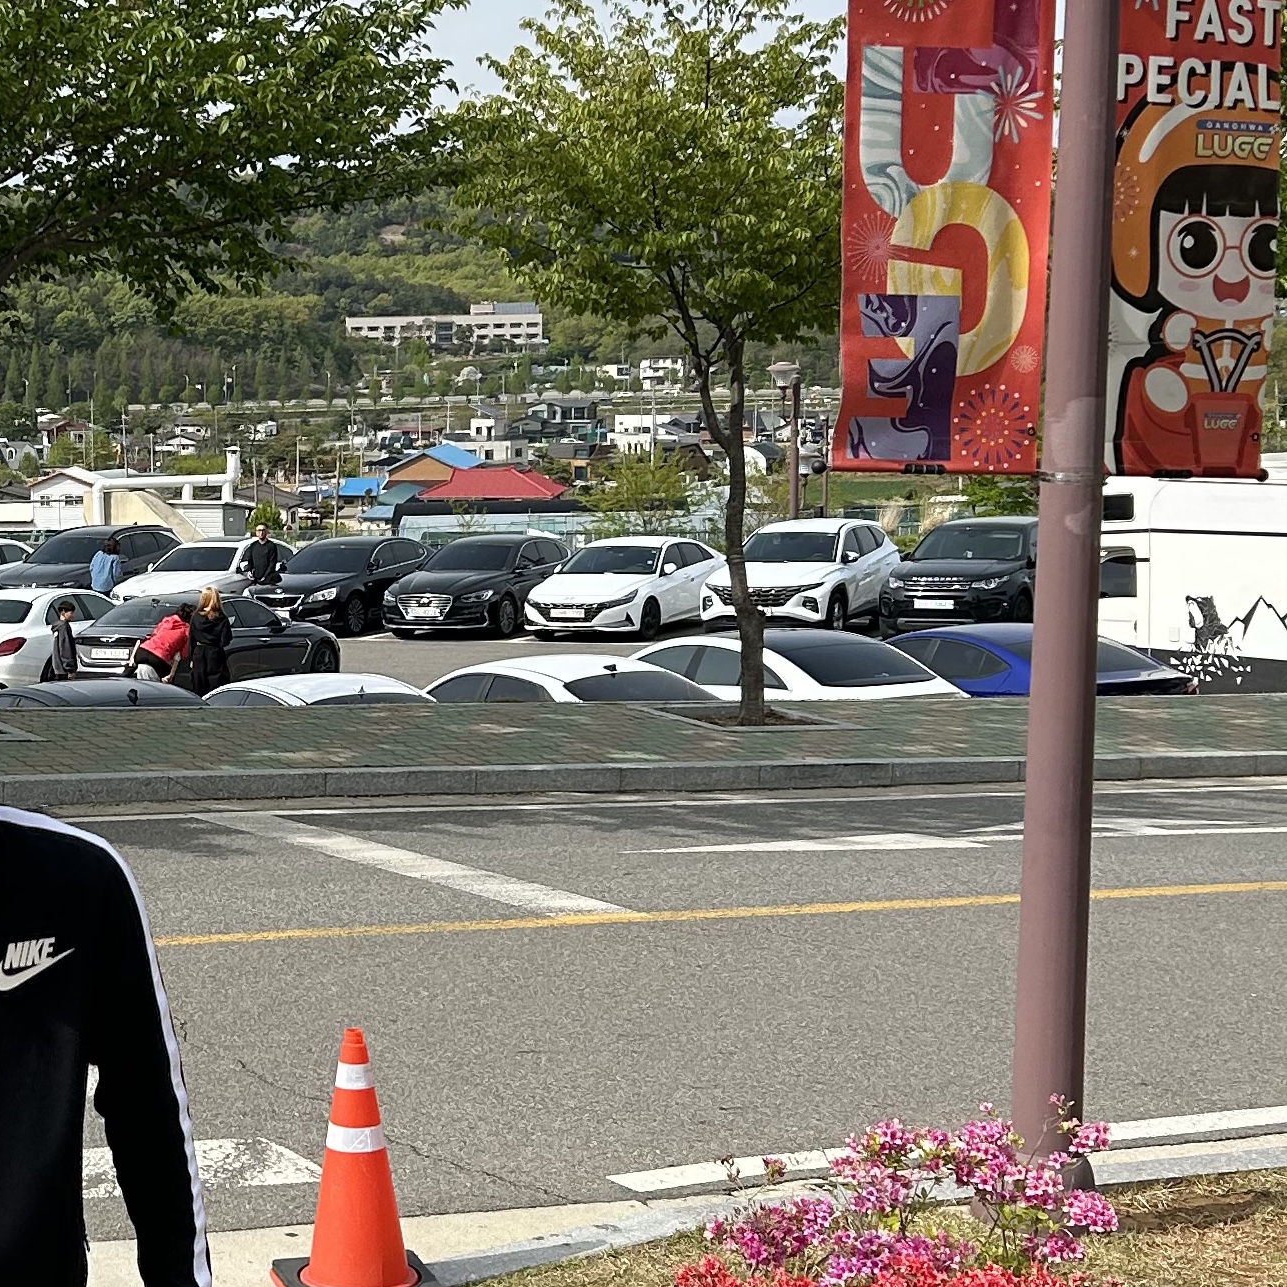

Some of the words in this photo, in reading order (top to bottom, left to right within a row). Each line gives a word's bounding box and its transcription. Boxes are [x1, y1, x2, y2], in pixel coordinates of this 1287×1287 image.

[1165, 0, 1281, 47] FAST
[1116, 53, 1281, 111] PECIAL
[3, 937, 56, 970] NIKE
